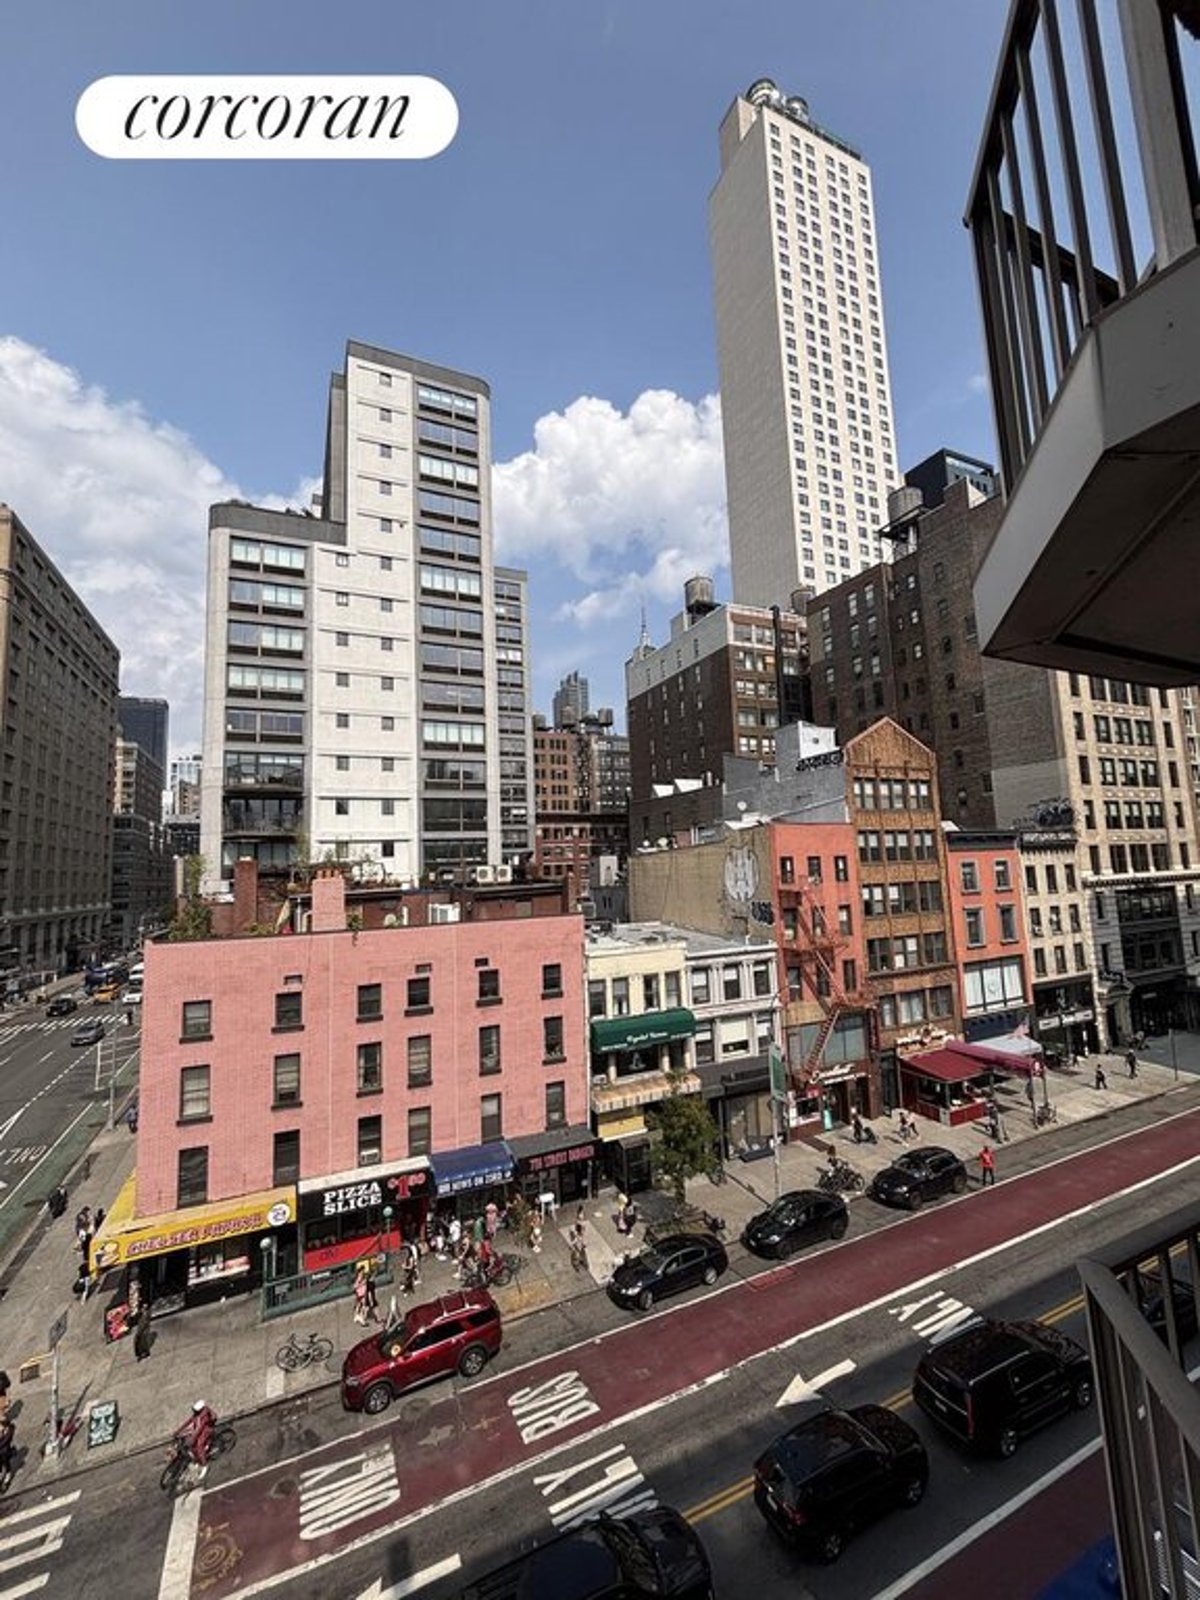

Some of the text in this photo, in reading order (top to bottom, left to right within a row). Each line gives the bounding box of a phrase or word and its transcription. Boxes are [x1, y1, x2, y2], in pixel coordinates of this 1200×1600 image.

[322, 1181, 381, 1203] PIZZA
[323, 1194, 383, 1216] SLICE
[507, 1370, 600, 1445] BUS
[298, 1443, 403, 1542] ONLY
